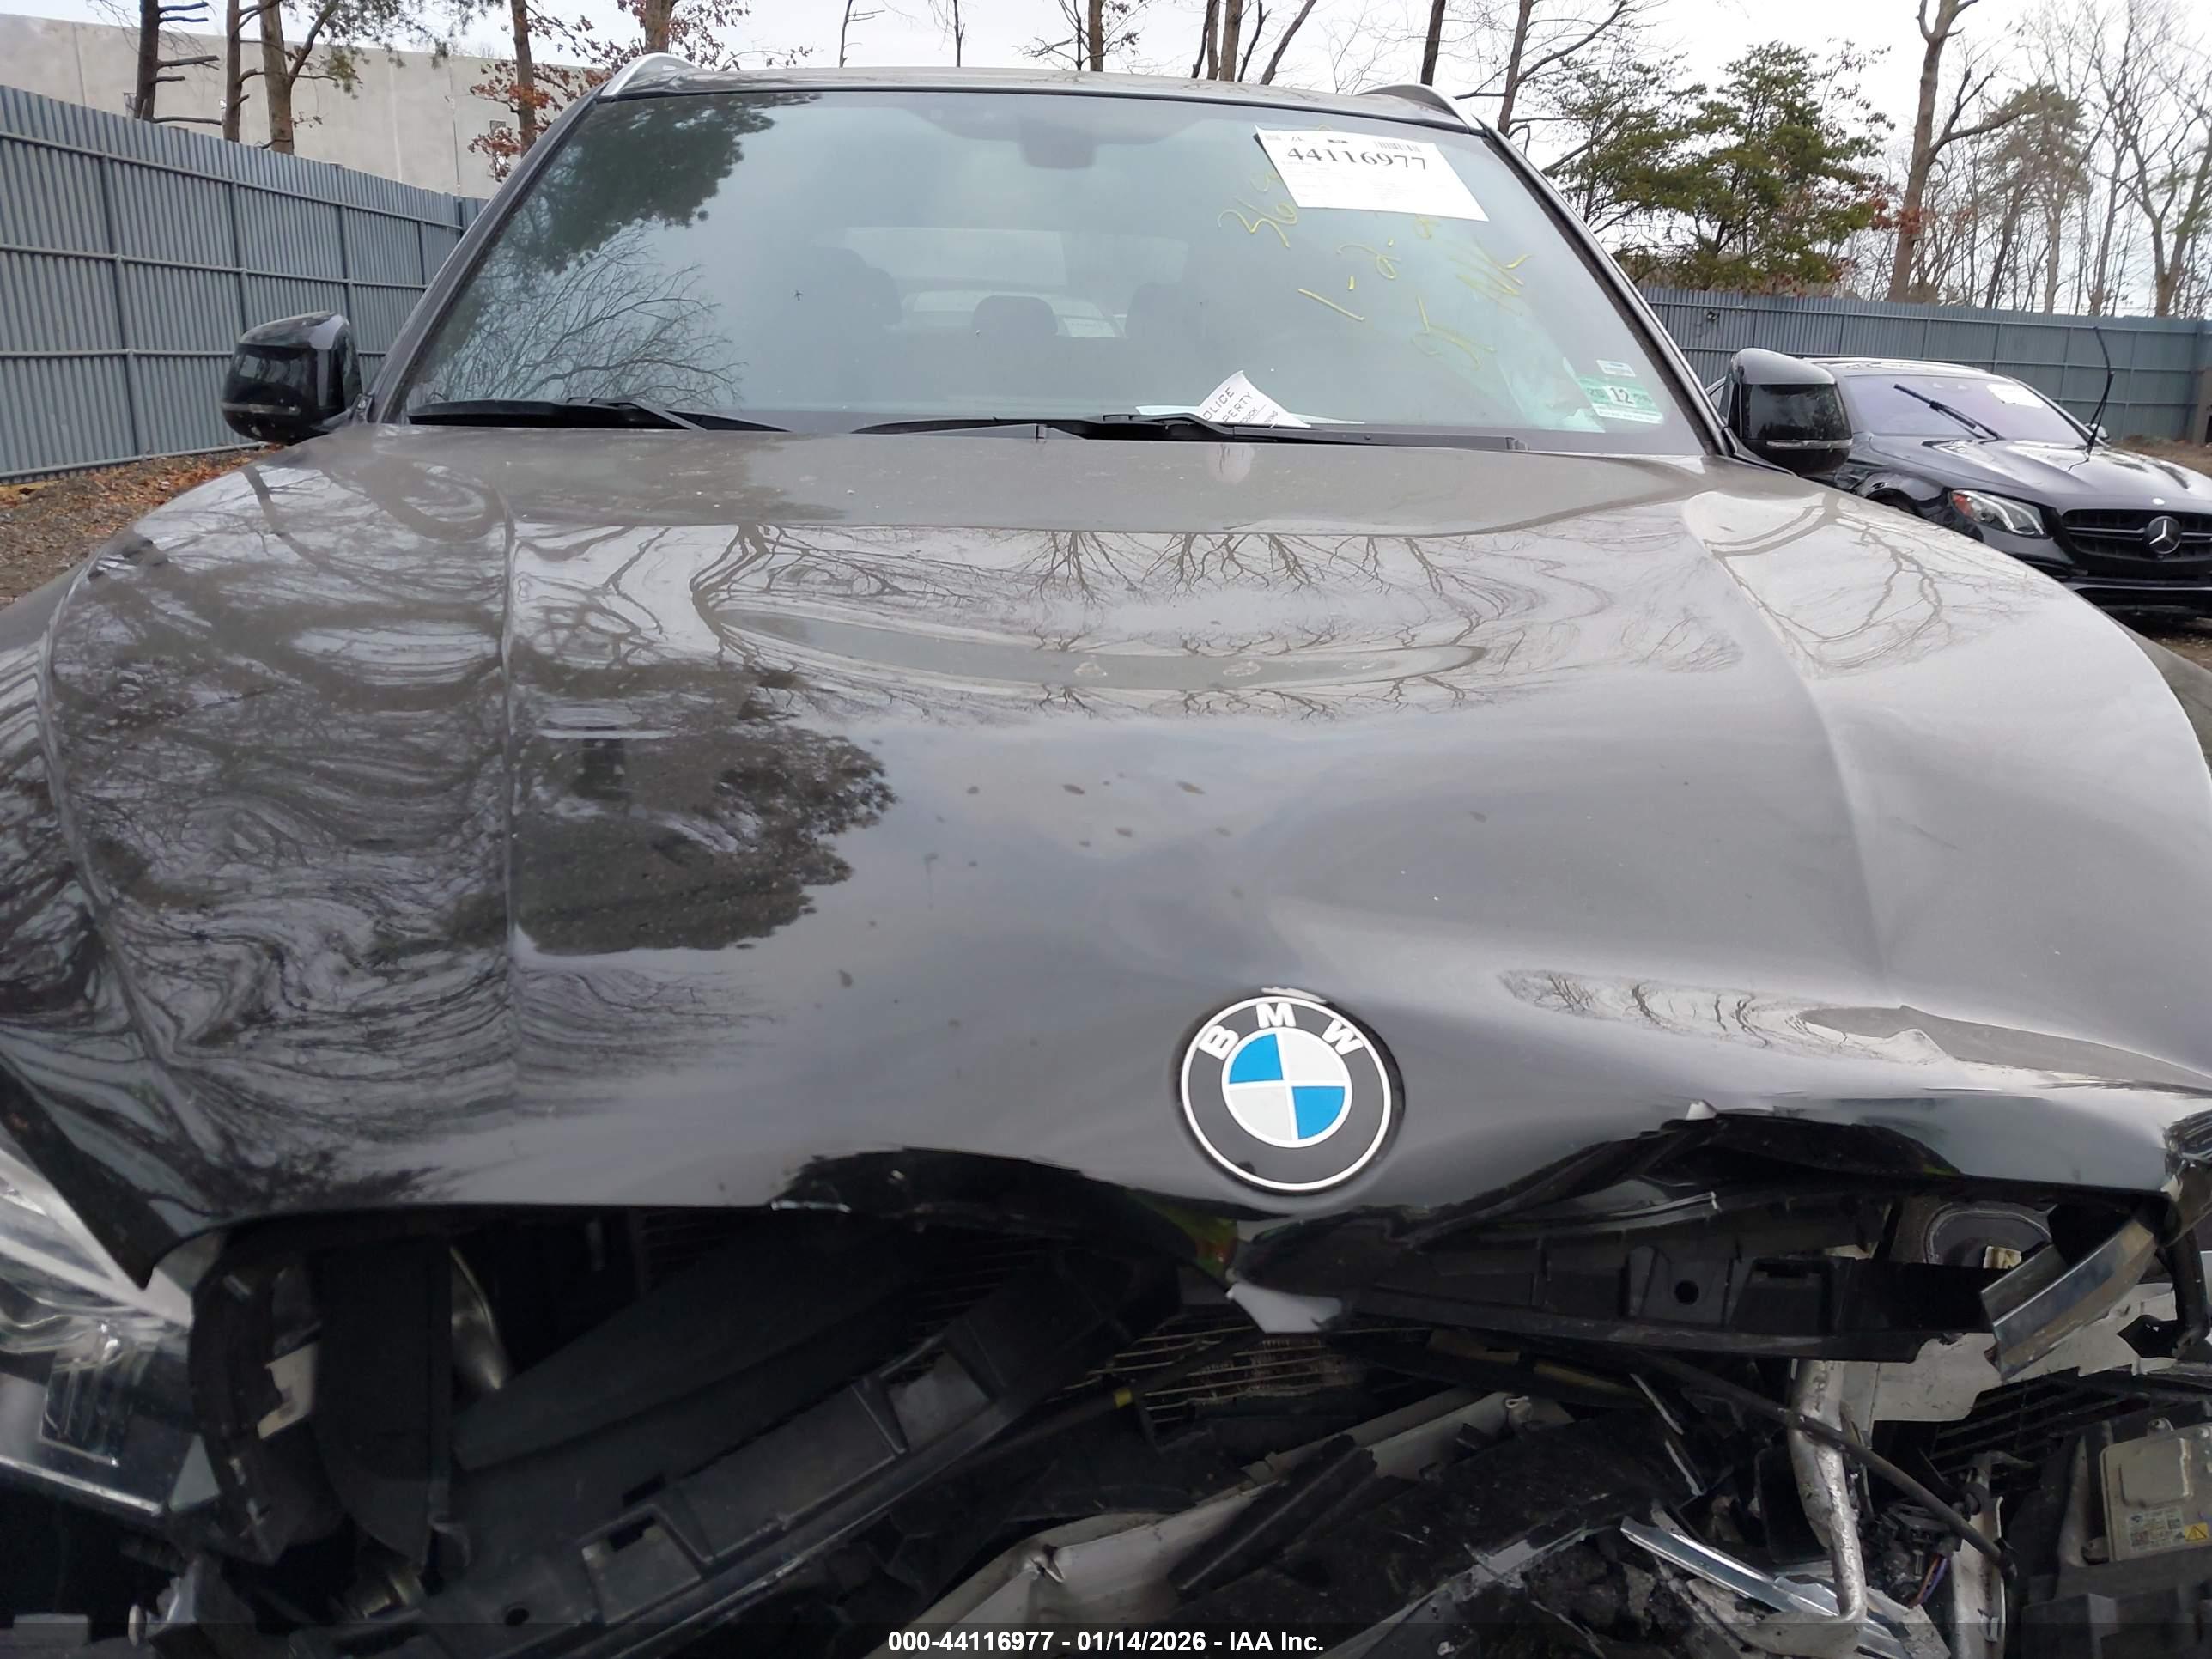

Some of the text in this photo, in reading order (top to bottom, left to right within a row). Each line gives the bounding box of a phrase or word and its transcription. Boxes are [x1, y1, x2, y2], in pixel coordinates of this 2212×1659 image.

[1287, 147, 1426, 171] 44116977
[1609, 386, 1634, 404] 12
[1198, 1002, 1364, 1061] BMW
